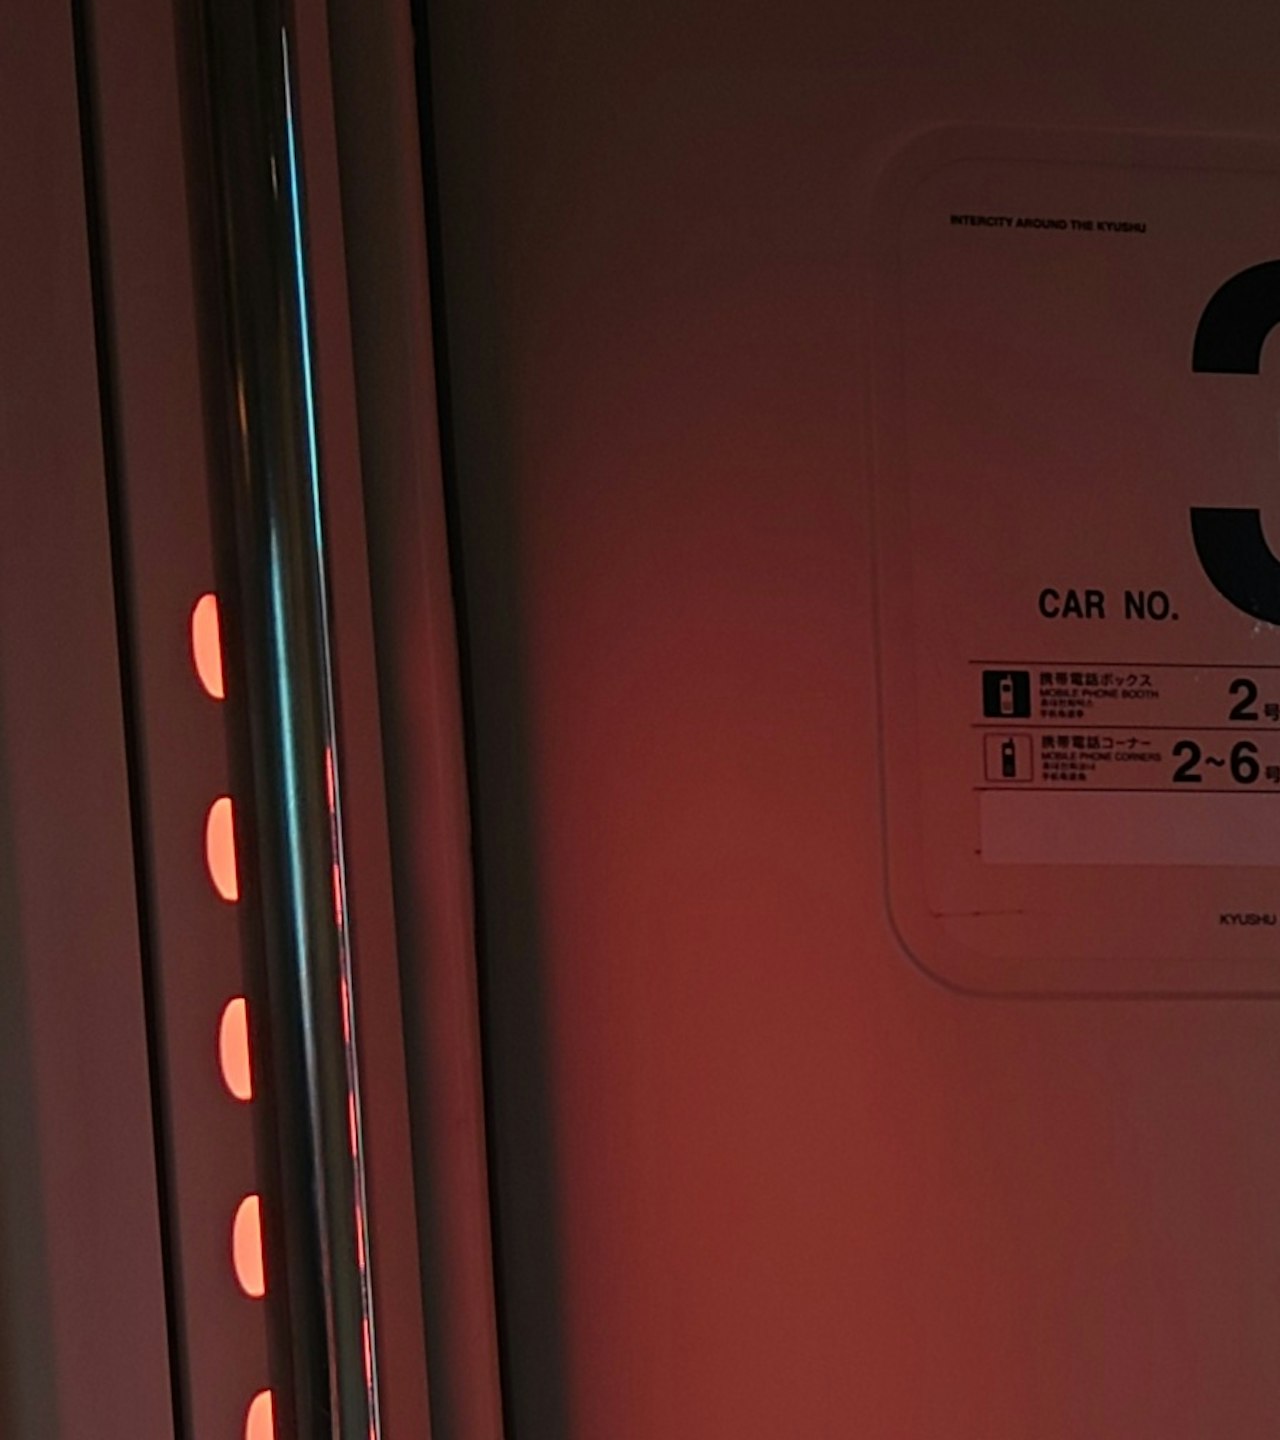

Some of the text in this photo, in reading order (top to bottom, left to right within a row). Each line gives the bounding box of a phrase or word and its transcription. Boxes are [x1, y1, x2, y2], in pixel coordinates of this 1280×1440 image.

[950, 214, 1147, 233] INTERCITY AROUND THE KYUSHU
[1037, 587, 1179, 620] CAR NO.
[1039, 671, 1152, 687] 携帯電話ボックス
[1039, 688, 1159, 699] MOBILE PHONE BOOTH
[1041, 735, 1152, 749] 携帯電話コーナー
[1041, 751, 1162, 762] MOBILE PHONE CORNERS
[1219, 913, 1277, 926] KYUSHU
